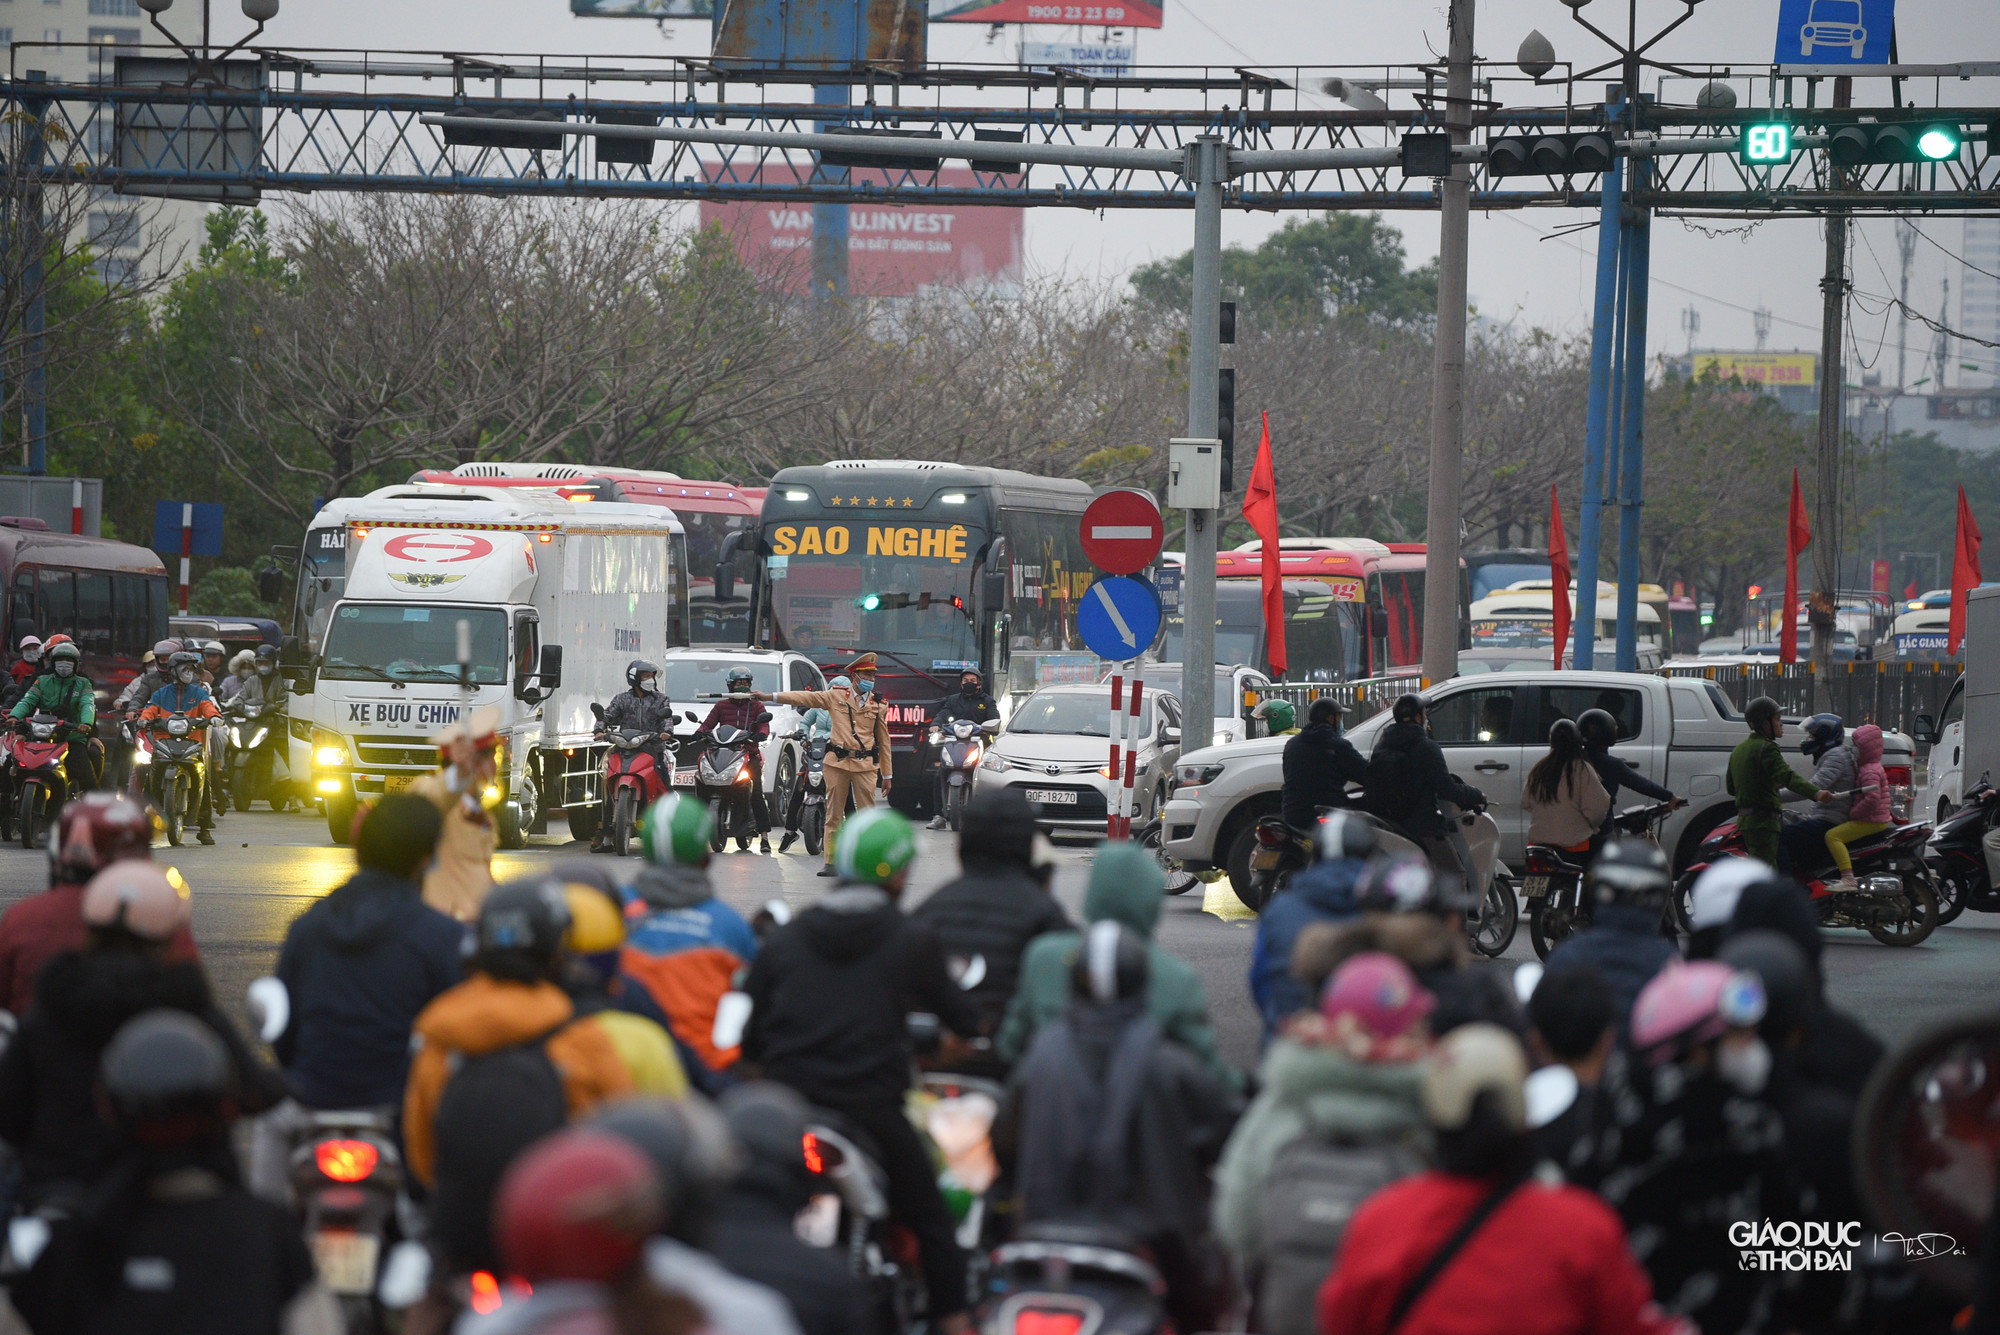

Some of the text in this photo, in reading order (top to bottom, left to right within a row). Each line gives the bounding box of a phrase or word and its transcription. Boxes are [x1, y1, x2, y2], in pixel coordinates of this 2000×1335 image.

[1027, 5, 1125, 20] 1900 23 23 89
[1748, 126, 1785, 158] 60
[320, 529, 346, 549] HẢI
[773, 524, 968, 564] SAO NGHỆ
[349, 702, 473, 724] XE BƯU CHÍN
[903, 704, 925, 726] NỘI
